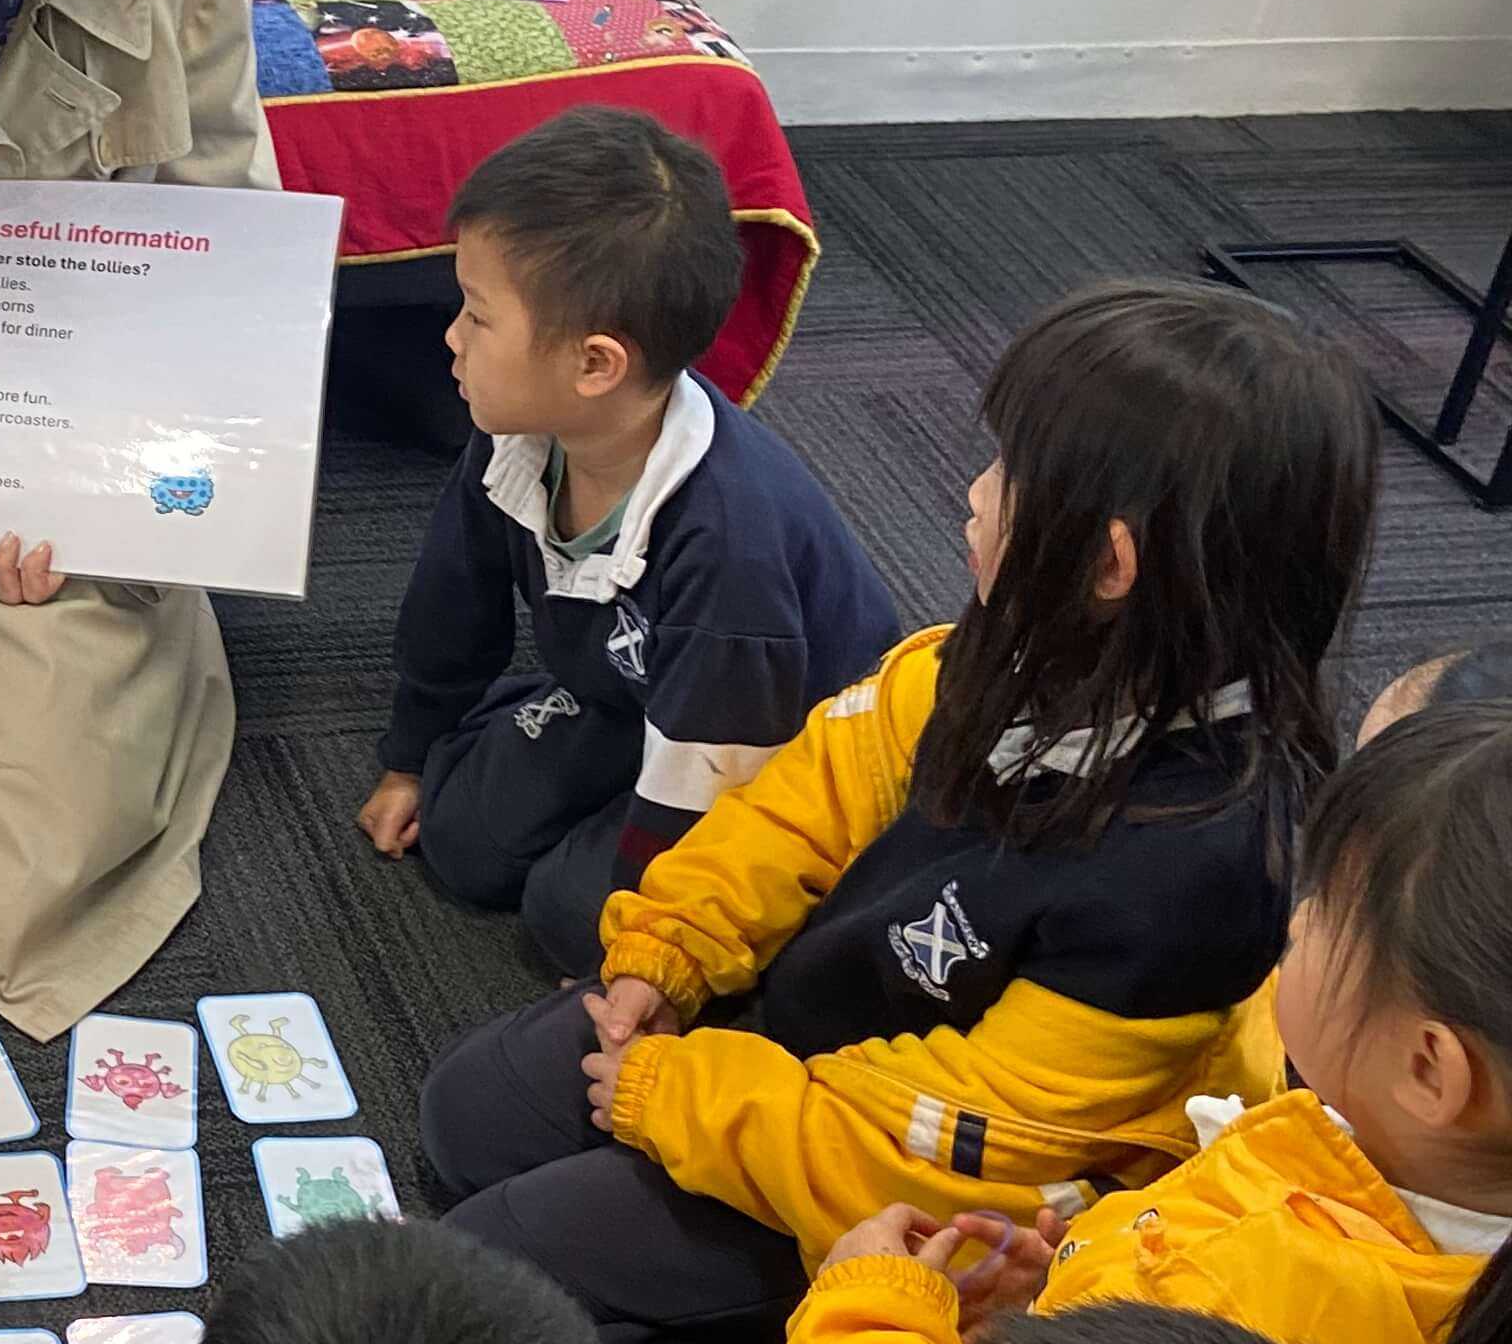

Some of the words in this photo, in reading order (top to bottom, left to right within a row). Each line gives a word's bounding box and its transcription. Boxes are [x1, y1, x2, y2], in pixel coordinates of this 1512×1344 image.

[67, 223, 210, 252] information
[16, 255, 56, 268] stole
[60, 257, 87, 270] the
[91, 259, 151, 276] lollies?
[2, 321, 22, 335] for
[25, 324, 74, 339] dinner
[24, 391, 52, 405] fun.
